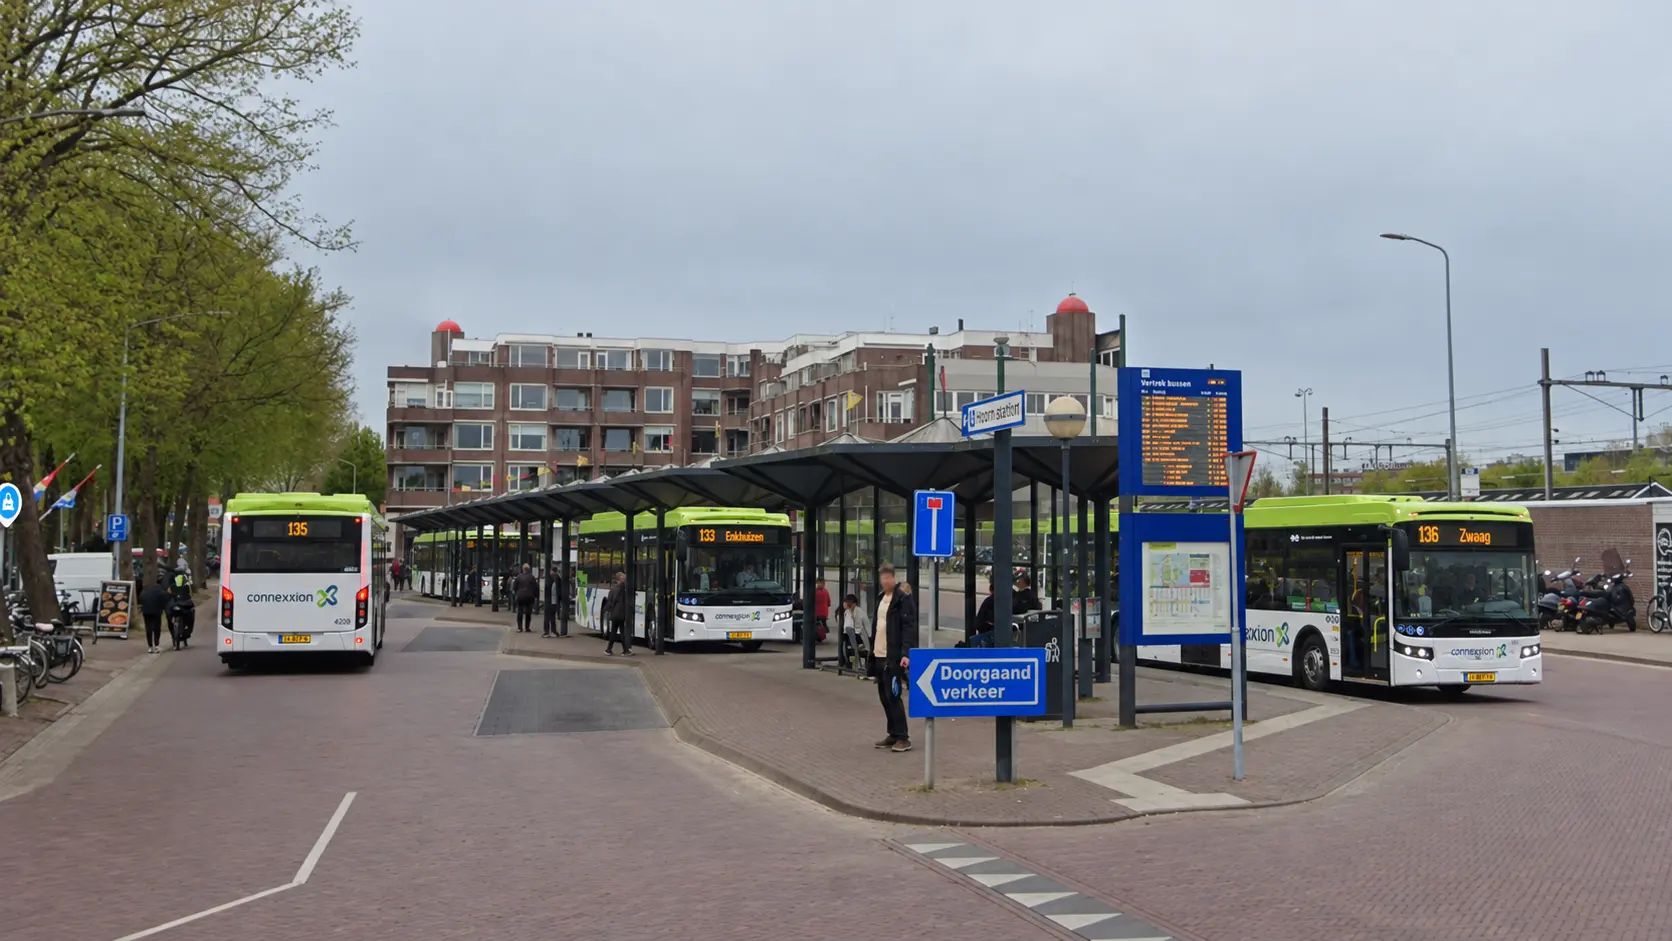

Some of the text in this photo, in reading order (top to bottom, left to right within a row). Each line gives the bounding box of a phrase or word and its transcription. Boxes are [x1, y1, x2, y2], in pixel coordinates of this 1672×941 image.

[112, 516, 122, 530] P
[288, 521, 308, 536] 135
[700, 528, 716, 542] 133
[1419, 525, 1491, 545] 136 Zwaag
[246, 592, 314, 603] connexxion
[941, 665, 1031, 684] Doorgaand
[941, 684, 1005, 699] verkeer
